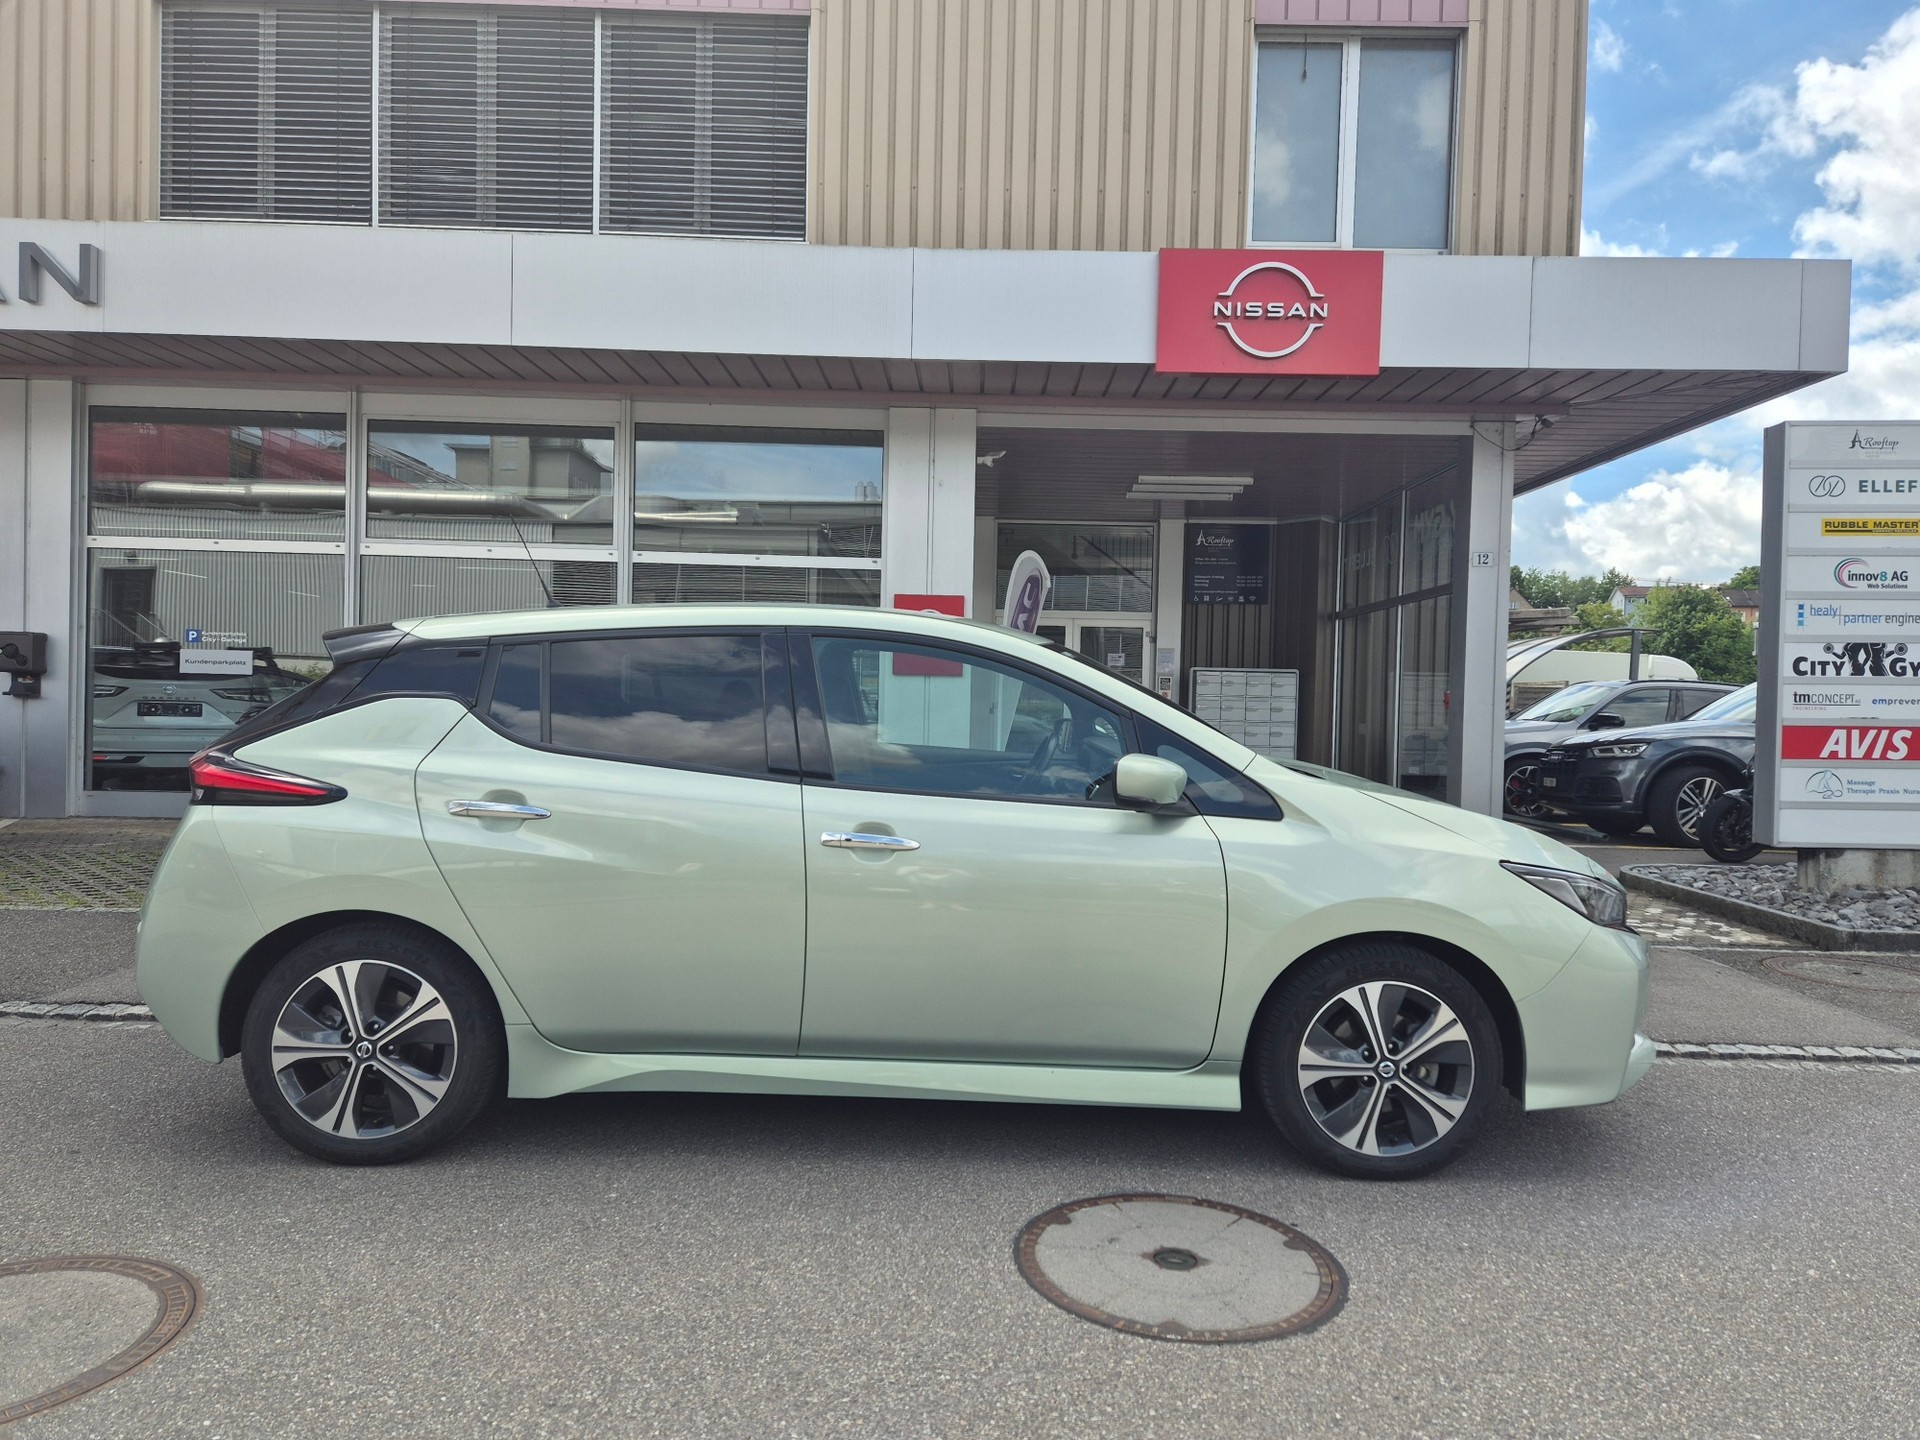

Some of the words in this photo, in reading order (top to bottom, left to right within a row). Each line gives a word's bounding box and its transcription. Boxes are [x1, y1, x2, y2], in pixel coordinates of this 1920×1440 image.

[0, 242, 98, 305] N
[1213, 301, 1329, 318] NISSAN
[1864, 436, 1899, 450] Rooftop
[1858, 480, 1918, 493] ELLEF
[1824, 521, 1869, 529] RUBBLE
[1873, 521, 1919, 529] MASTER
[1477, 553, 1489, 565] 12
[1847, 570, 1888, 582] innov8
[1891, 570, 1909, 582] AG
[1809, 604, 1838, 619] healy
[1843, 612, 1882, 626] partner
[1792, 656, 1847, 677] CITY
[1818, 728, 1913, 760] AVIS
[1846, 779, 1876, 787] Massage
[1846, 787, 1877, 795] Therapie
[1879, 787, 1901, 795] Praxis
